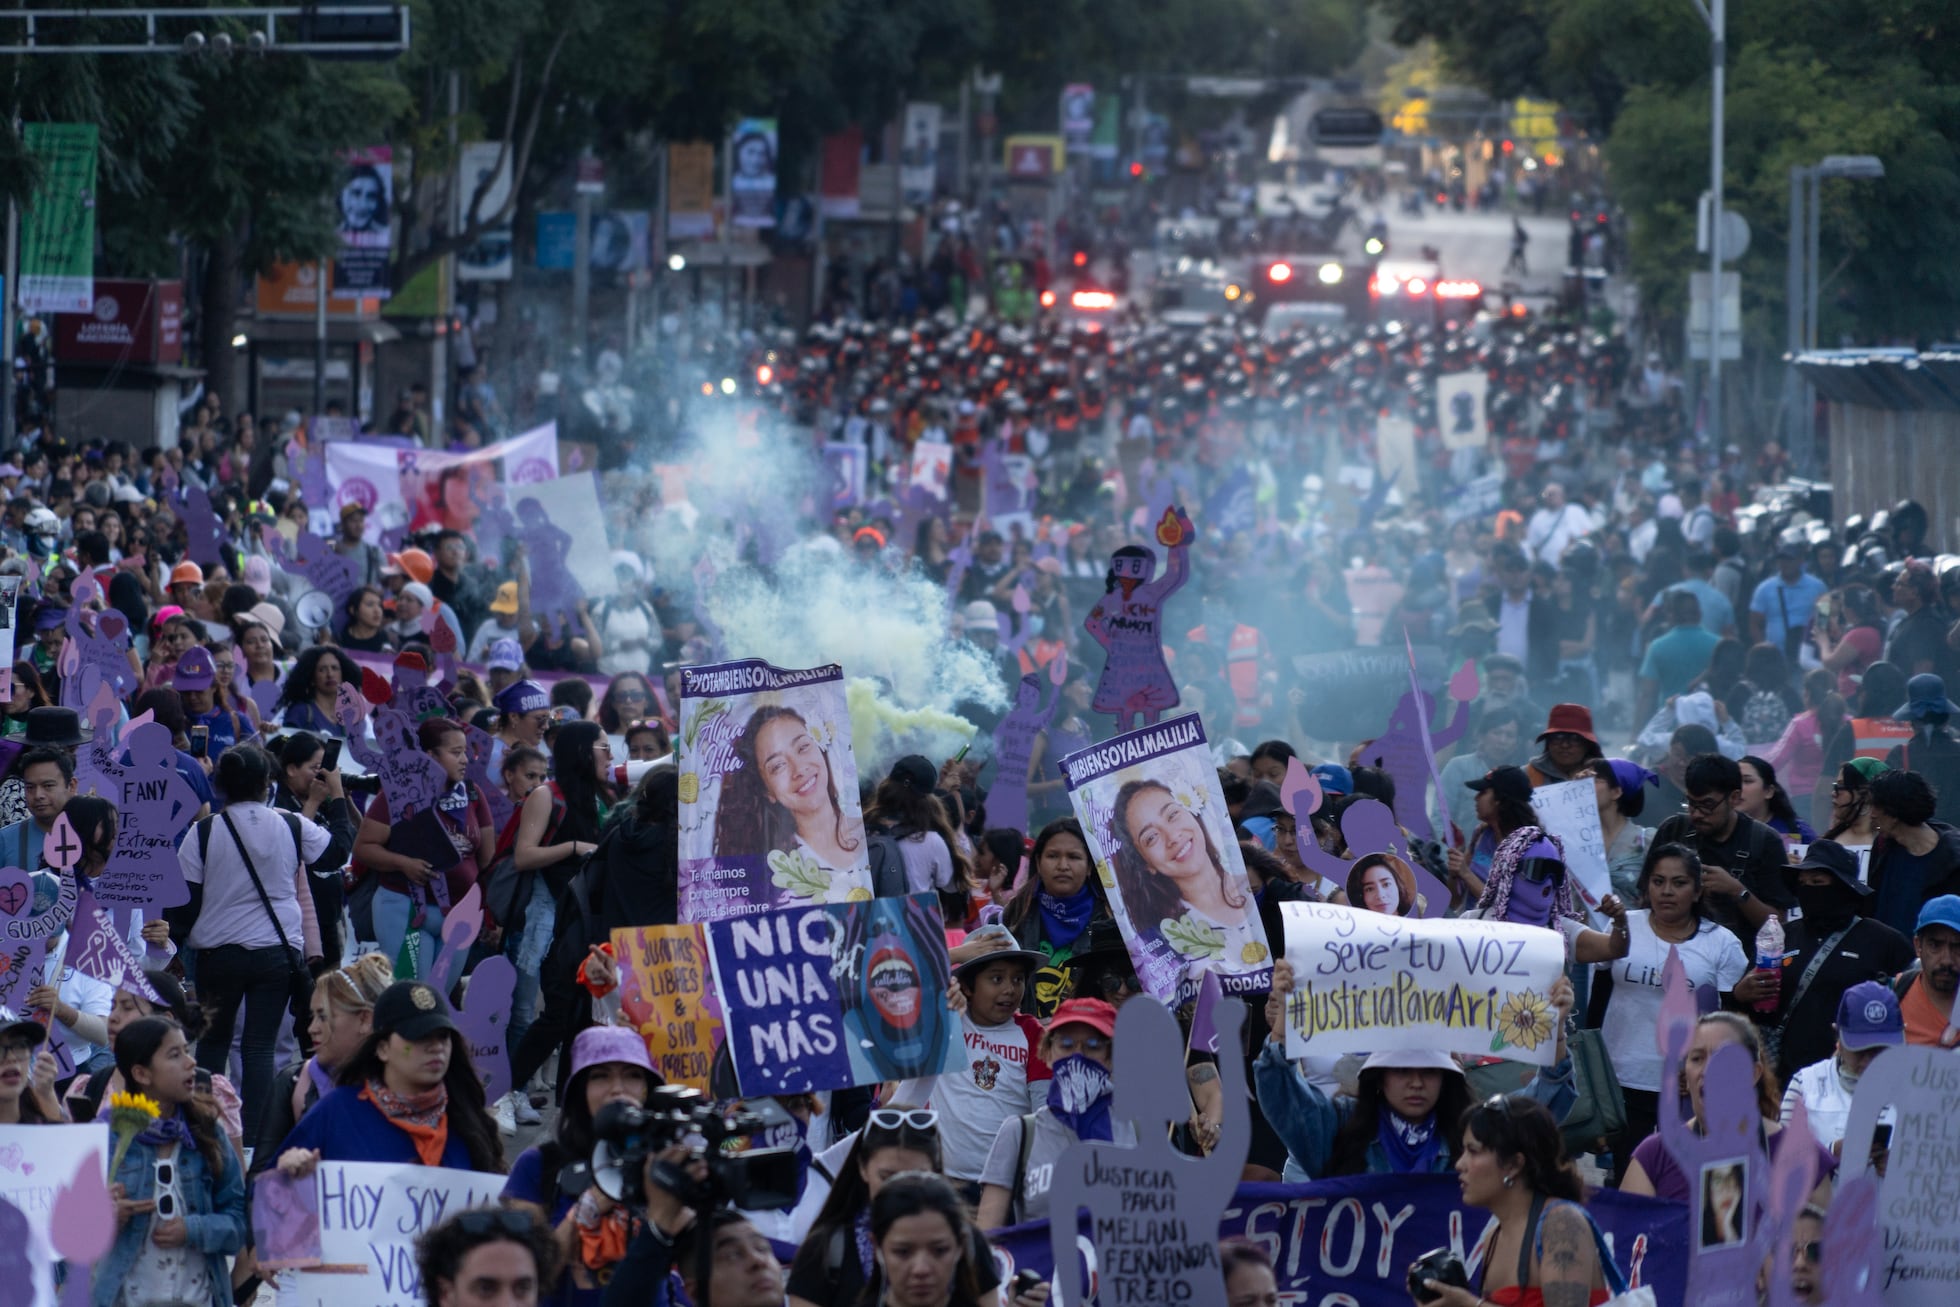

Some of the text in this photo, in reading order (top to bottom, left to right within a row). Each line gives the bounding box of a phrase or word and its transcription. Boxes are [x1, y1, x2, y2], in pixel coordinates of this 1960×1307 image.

[700, 713, 746, 743] Alma
[703, 742, 744, 780] Lilia
[123, 779, 168, 803] FANY
[119, 812, 138, 829] Te
[116, 850, 152, 860] mos
[98, 881, 148, 891] nuestros
[704, 886, 750, 899] siempre
[7, 869, 77, 940] GUADALUPE
[718, 903, 769, 916] siempre
[93, 909, 160, 1002] #JUSTICIAPARAARI
[1317, 933, 1530, 977] seré tu VOZ
[652, 965, 698, 997] LIBRES
[737, 962, 829, 1008] UNA
[1224, 972, 1271, 993] TODAS
[674, 1000, 687, 1016] &
[1288, 970, 1498, 1042] #JusticiaParaAri
[668, 1022, 697, 1049] SIN
[750, 1010, 838, 1065] MÁS
[321, 1167, 384, 1230] HOY
[1121, 1191, 1175, 1212] PARA
[1097, 1217, 1188, 1246] MELANI
[1104, 1241, 1218, 1276] FERNANDA
[1112, 1277, 1192, 1304] TREJO
